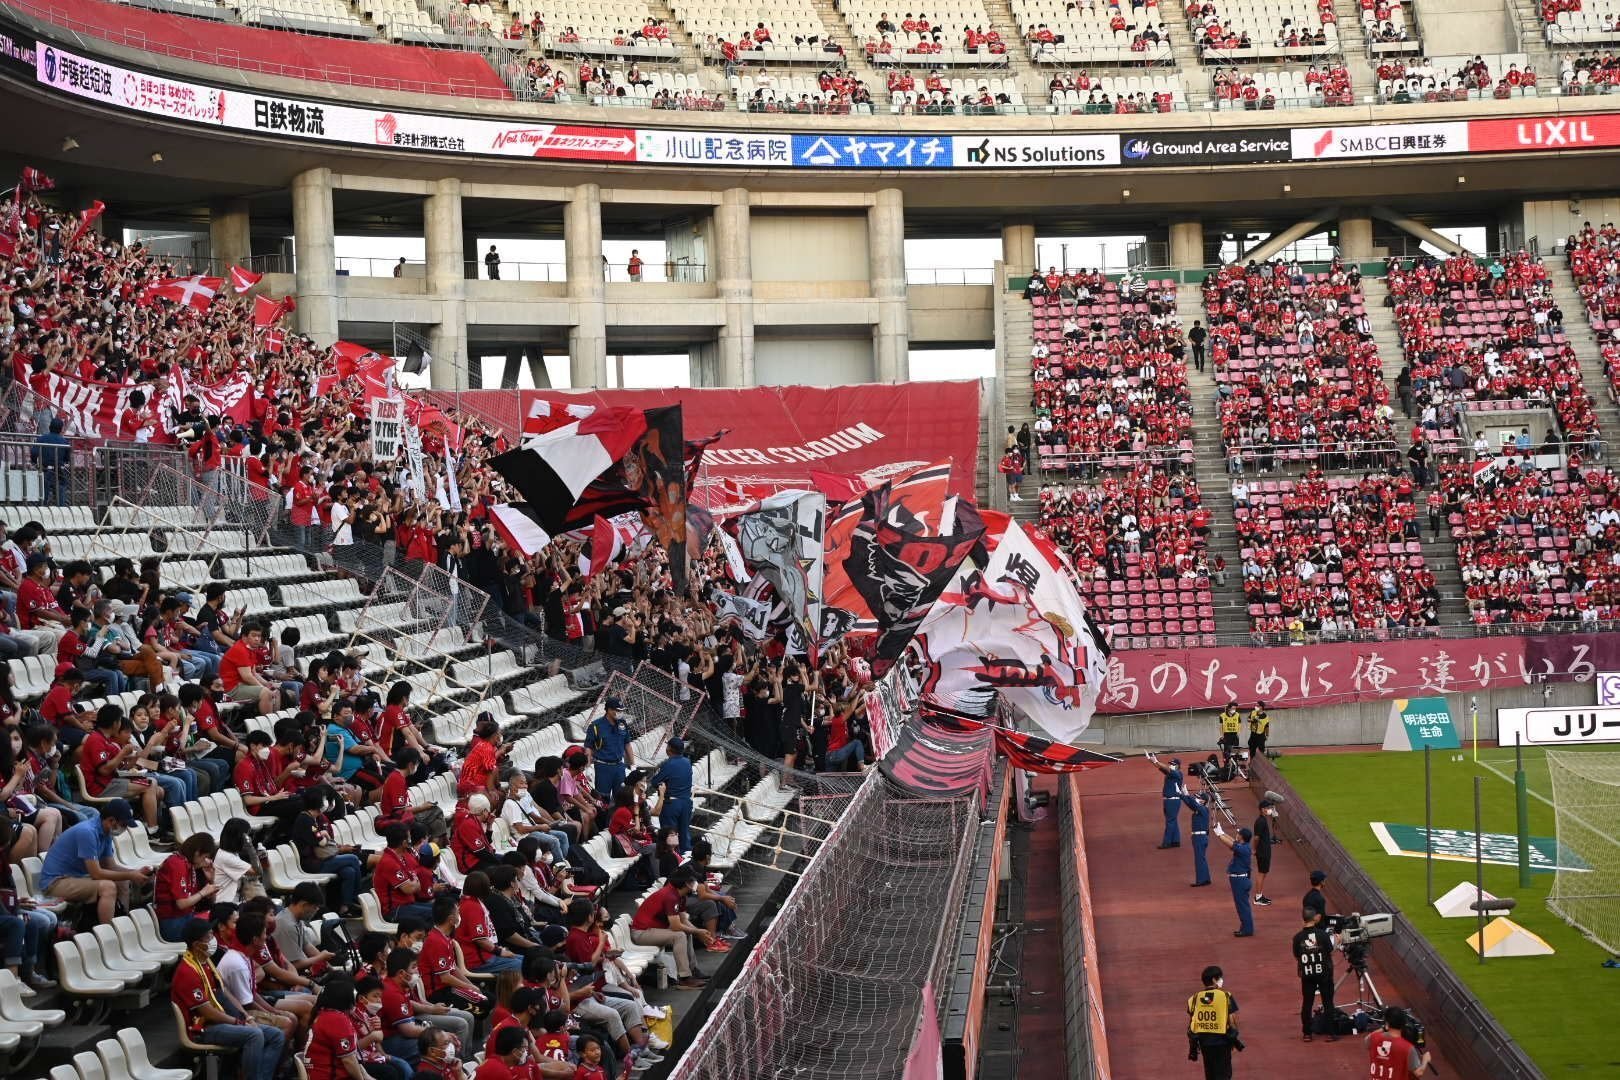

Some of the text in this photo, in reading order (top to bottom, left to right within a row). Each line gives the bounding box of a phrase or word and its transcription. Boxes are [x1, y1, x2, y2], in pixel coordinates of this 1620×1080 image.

[59, 55, 113, 97] 伊藤超短波
[254, 100, 325, 136] 日鉄物流
[393, 132, 466, 151] 東洋計測株式会社
[1517, 119, 1596, 146] LIXIL
[666, 136, 788, 162] 小山記念病院
[844, 137, 945, 166] ヤマイチ
[1152, 138, 1290, 156] Ground Area Service
[1340, 134, 1448, 153] SMBC日興証券
[994, 146, 1106, 163] NS Solutions
[382, 421, 399, 438] THE
[767, 421, 886, 464] STADIUM
[1403, 712, 1450, 726] 明治安田
[1419, 726, 1443, 738] 生命
[1301, 952, 1323, 964] 011
[1197, 1010, 1217, 1022] 008
[1370, 1062, 1394, 1079] 011
